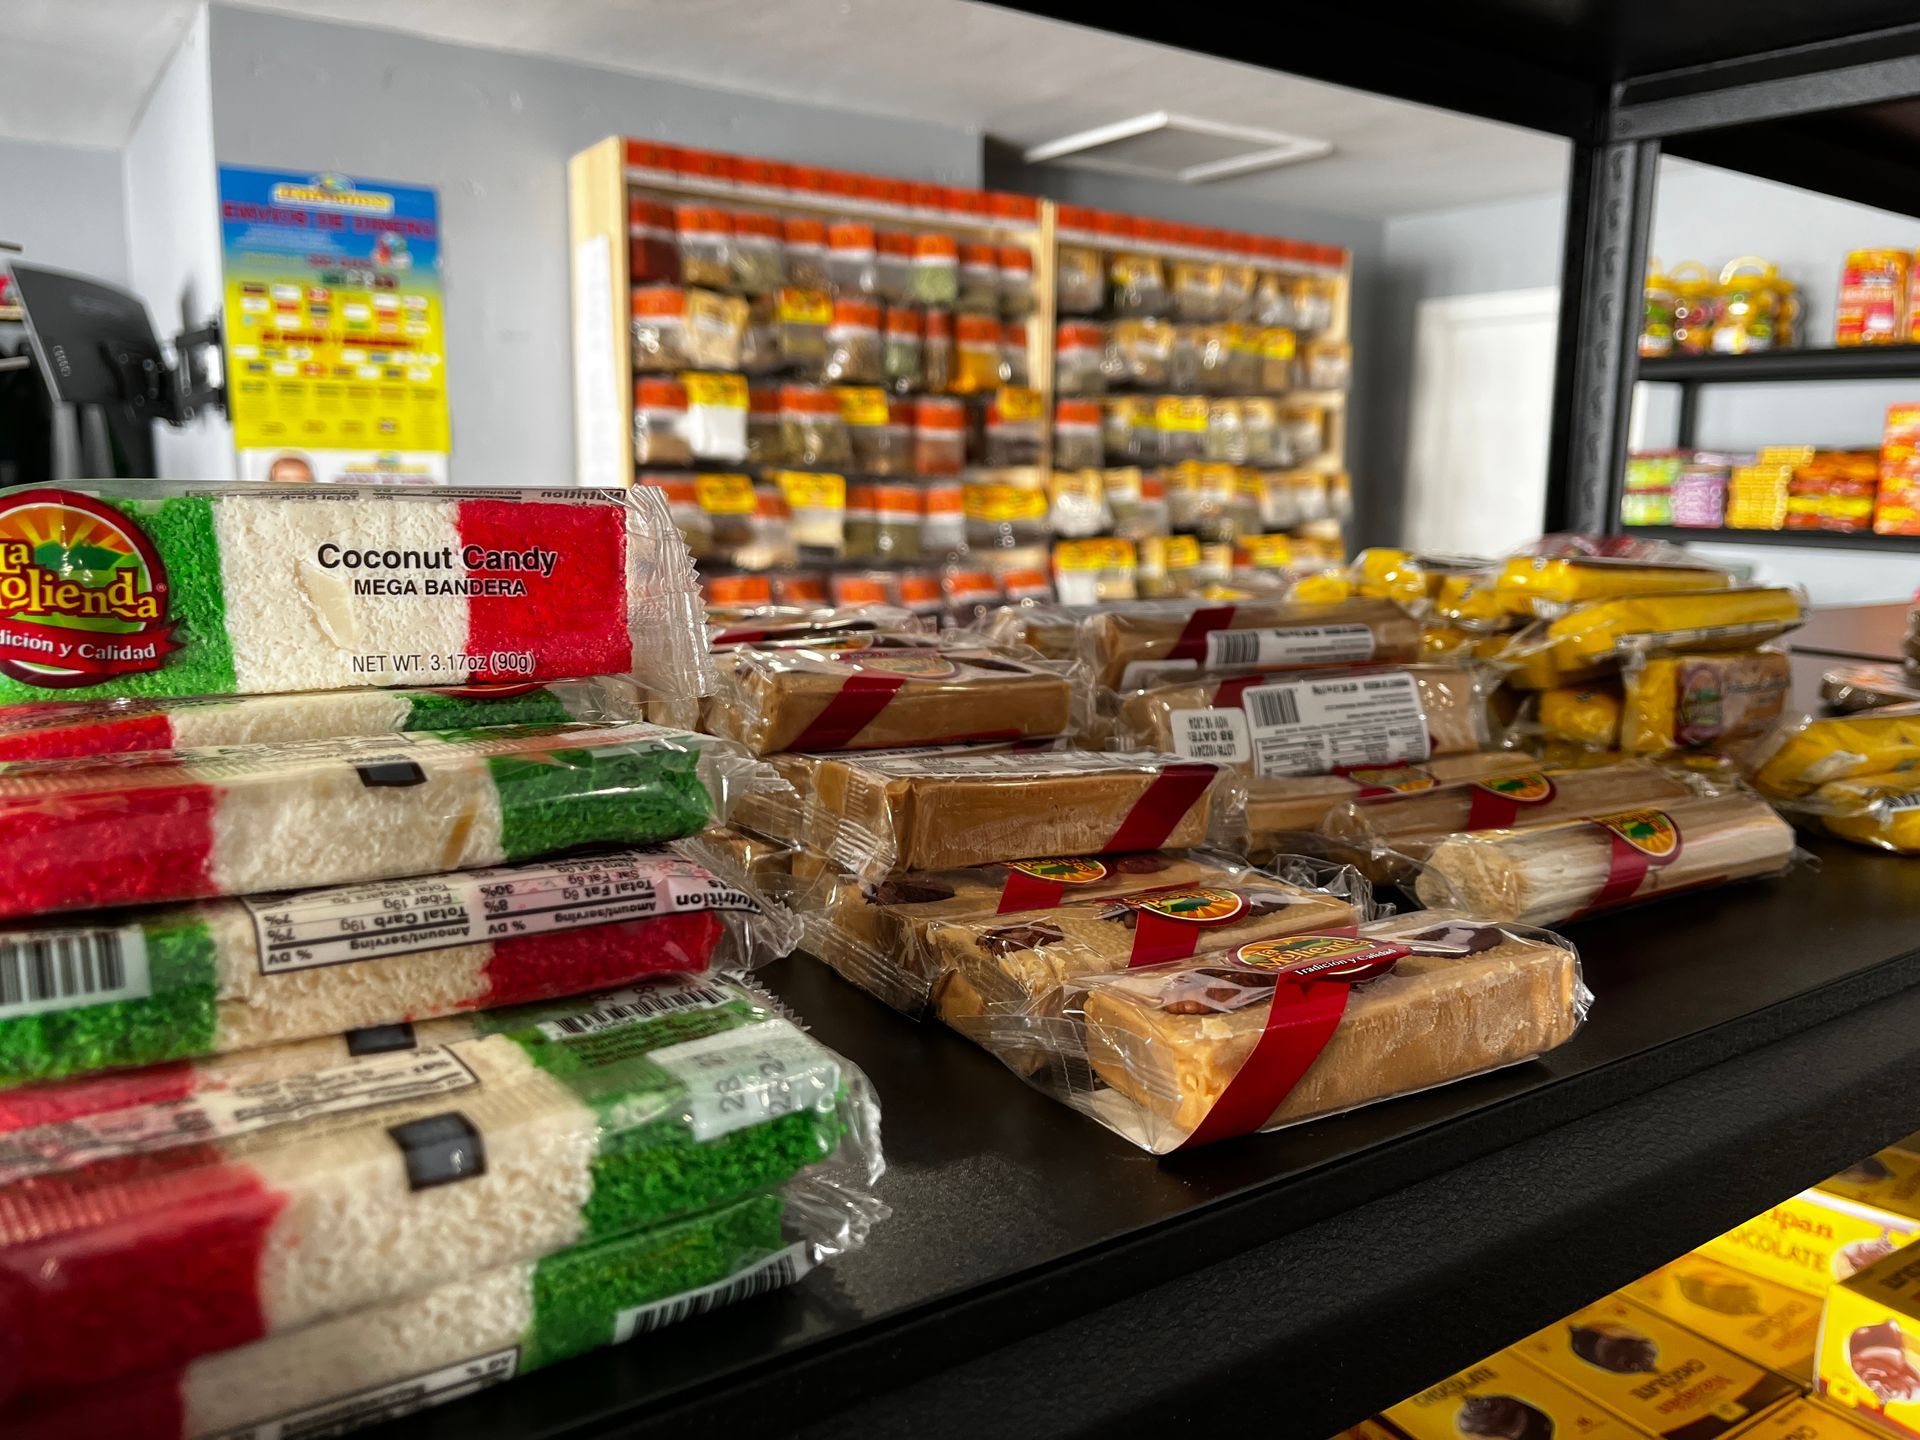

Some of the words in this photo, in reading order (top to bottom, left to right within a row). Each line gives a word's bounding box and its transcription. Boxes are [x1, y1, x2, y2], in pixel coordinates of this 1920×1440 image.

[317, 543, 452, 570] Coconut
[462, 544, 557, 577] Candy
[0, 568, 159, 618] olienda
[354, 578, 418, 597] MEGA
[424, 578, 527, 597] BANDERA
[58, 643, 73, 659] y
[77, 643, 157, 661] Calidad
[352, 654, 387, 673] NET
[393, 654, 424, 672] WT.
[430, 653, 488, 672] 3.17oz
[491, 651, 536, 674] (90g)
[589, 872, 612, 882] Fat
[562, 888, 579, 900] 6g
[585, 885, 611, 898] Fat
[617, 879, 656, 896] Total
[383, 898, 408, 911] 19g
[418, 892, 453, 906] Fiber
[424, 906, 468, 922] Total
[484, 900, 508, 914] 8%
[554, 901, 656, 923] Amount/serving
[341, 919, 366, 932] 19g
[374, 912, 418, 927] Carb
[511, 919, 526, 931] %
[267, 928, 296, 943] 7%
[487, 922, 508, 935] DV
[350, 926, 470, 950] Amount/serving
[267, 953, 291, 966] DV
[296, 949, 312, 961] %
[1255, 938, 1373, 970] Molienda
[1294, 957, 1350, 976] Tradición
[1356, 948, 1398, 962] Calidad
